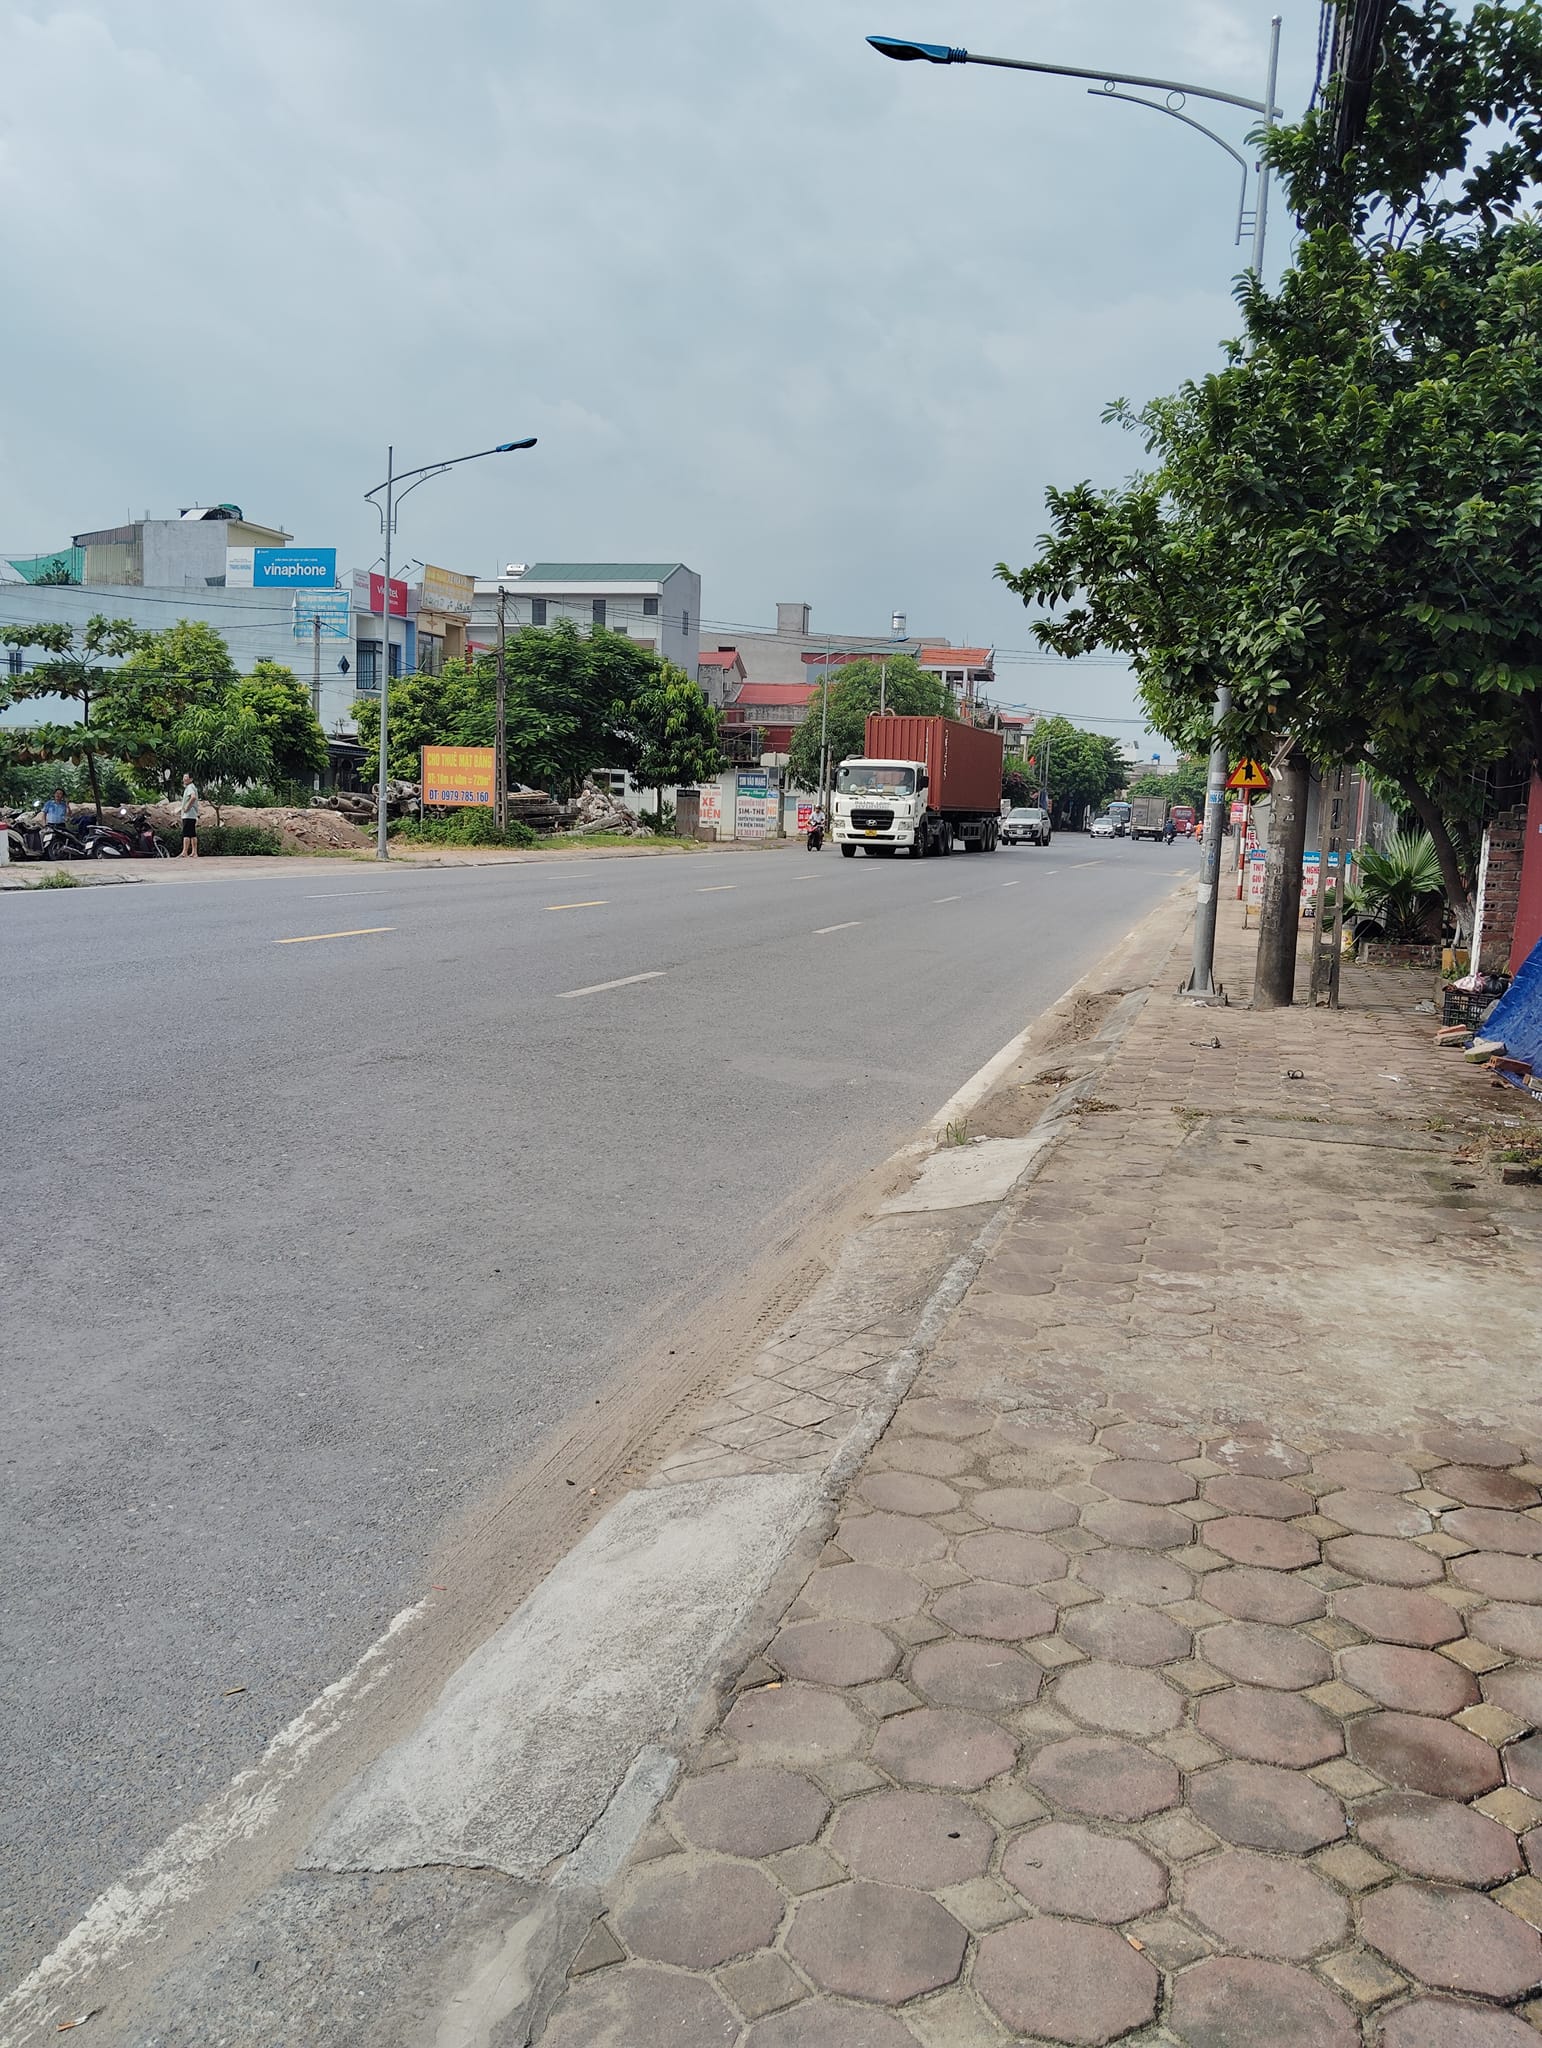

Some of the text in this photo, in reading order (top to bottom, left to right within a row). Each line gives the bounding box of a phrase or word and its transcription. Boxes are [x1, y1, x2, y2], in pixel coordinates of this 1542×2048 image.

[263, 563, 327, 578] vinaphone
[427, 751, 492, 770] CHO THUÊ MẶT BẰNG
[441, 790, 489, 802] 0979.785.160
[702, 797, 715, 807] XE
